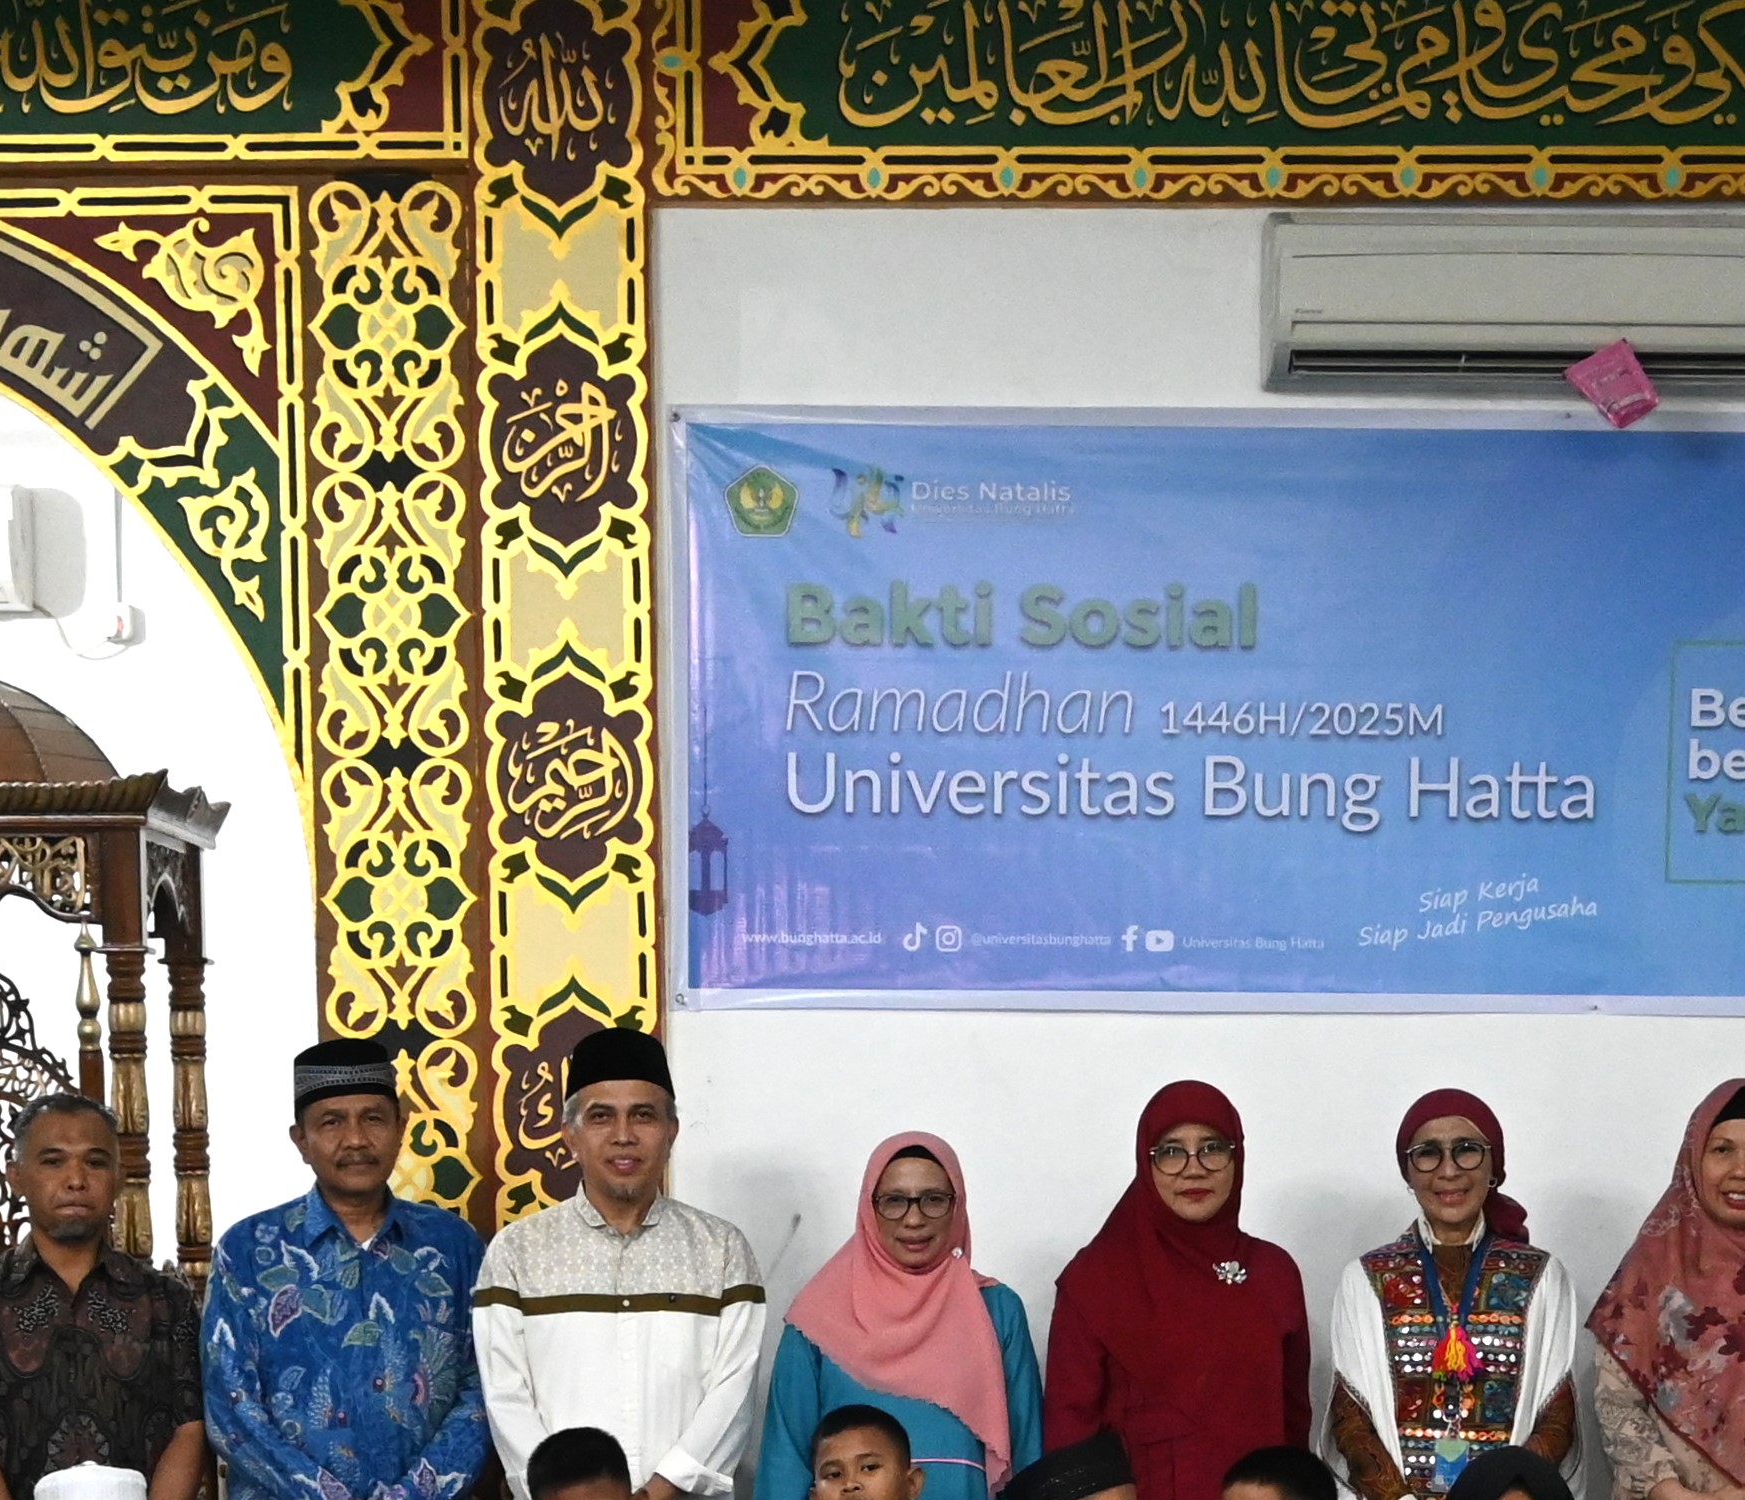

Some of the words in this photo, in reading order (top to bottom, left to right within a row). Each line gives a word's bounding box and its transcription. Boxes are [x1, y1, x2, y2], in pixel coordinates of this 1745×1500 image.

[911, 480, 969, 501] Dies
[979, 480, 1072, 501] Natalis
[785, 581, 993, 648] Bakti
[1020, 584, 1259, 650] Sosial
[786, 670, 1135, 736] Ramadhan
[1160, 701, 1445, 739] 1446H/2025M
[786, 751, 1176, 818] Universitas
[1204, 755, 1380, 831] Bung
[1410, 757, 1597, 823] Hatta
[1419, 887, 1468, 914] Siap
[1478, 873, 1540, 902] Kerja
[741, 930, 882, 946] www.bunghatta.ac.id
[970, 931, 1112, 948] @universitasbunghatta
[1182, 935, 1251, 950] Universitas
[1255, 935, 1286, 952] Bung
[1290, 935, 1325, 950] Hatta
[1358, 923, 1408, 952] Siap
[1417, 912, 1468, 941] Jadi
[1476, 896, 1598, 931] Pengusaha
